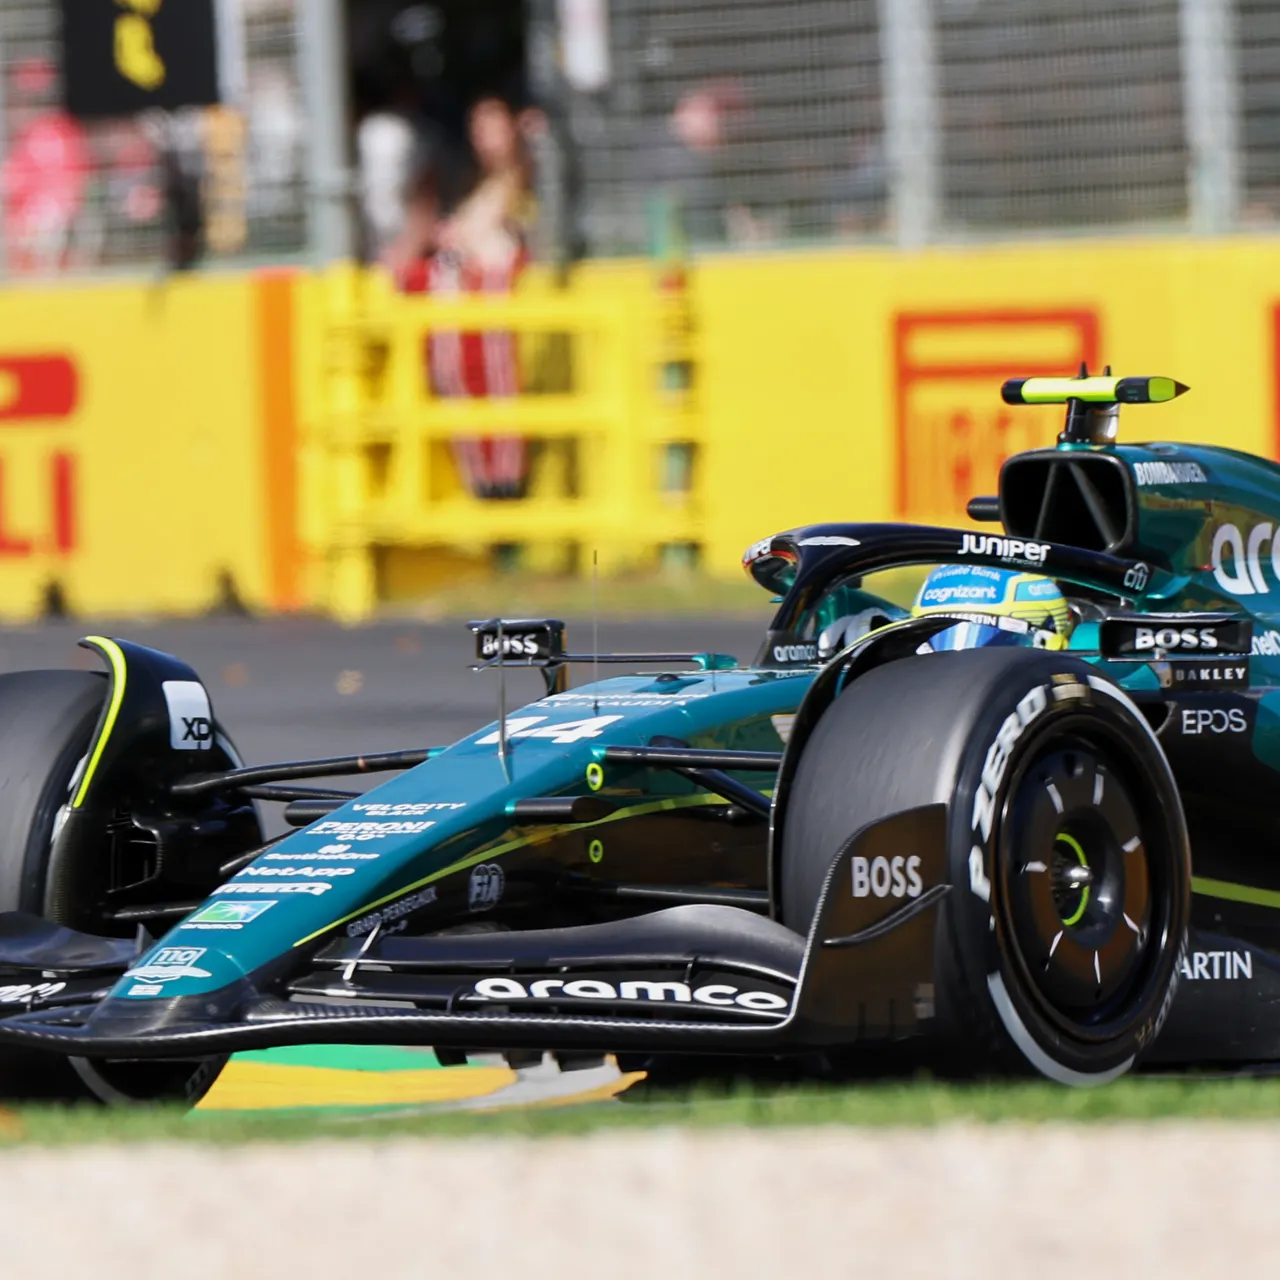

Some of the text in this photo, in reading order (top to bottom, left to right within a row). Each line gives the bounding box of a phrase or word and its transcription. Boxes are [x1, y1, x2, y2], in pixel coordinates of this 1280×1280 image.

[1124, 562, 1149, 592] citi
[924, 584, 997, 602] cognizant
[482, 633, 539, 655] BOSS
[1135, 627, 1218, 650] BOSS
[774, 645, 817, 662] aramco
[1176, 667, 1246, 682] OAKLEY
[474, 715, 624, 744] 14
[1182, 708, 1247, 736] EPOS
[971, 684, 1047, 843] ZERO
[352, 802, 468, 811] VELOCITY
[312, 821, 436, 832] PERONI
[235, 866, 356, 877] NetApp
[851, 855, 923, 898] BOSS
[471, 873, 504, 903] FIA
[157, 950, 198, 962] 110
[1180, 950, 1253, 980] ARTIN
[474, 977, 788, 1010] aramco
